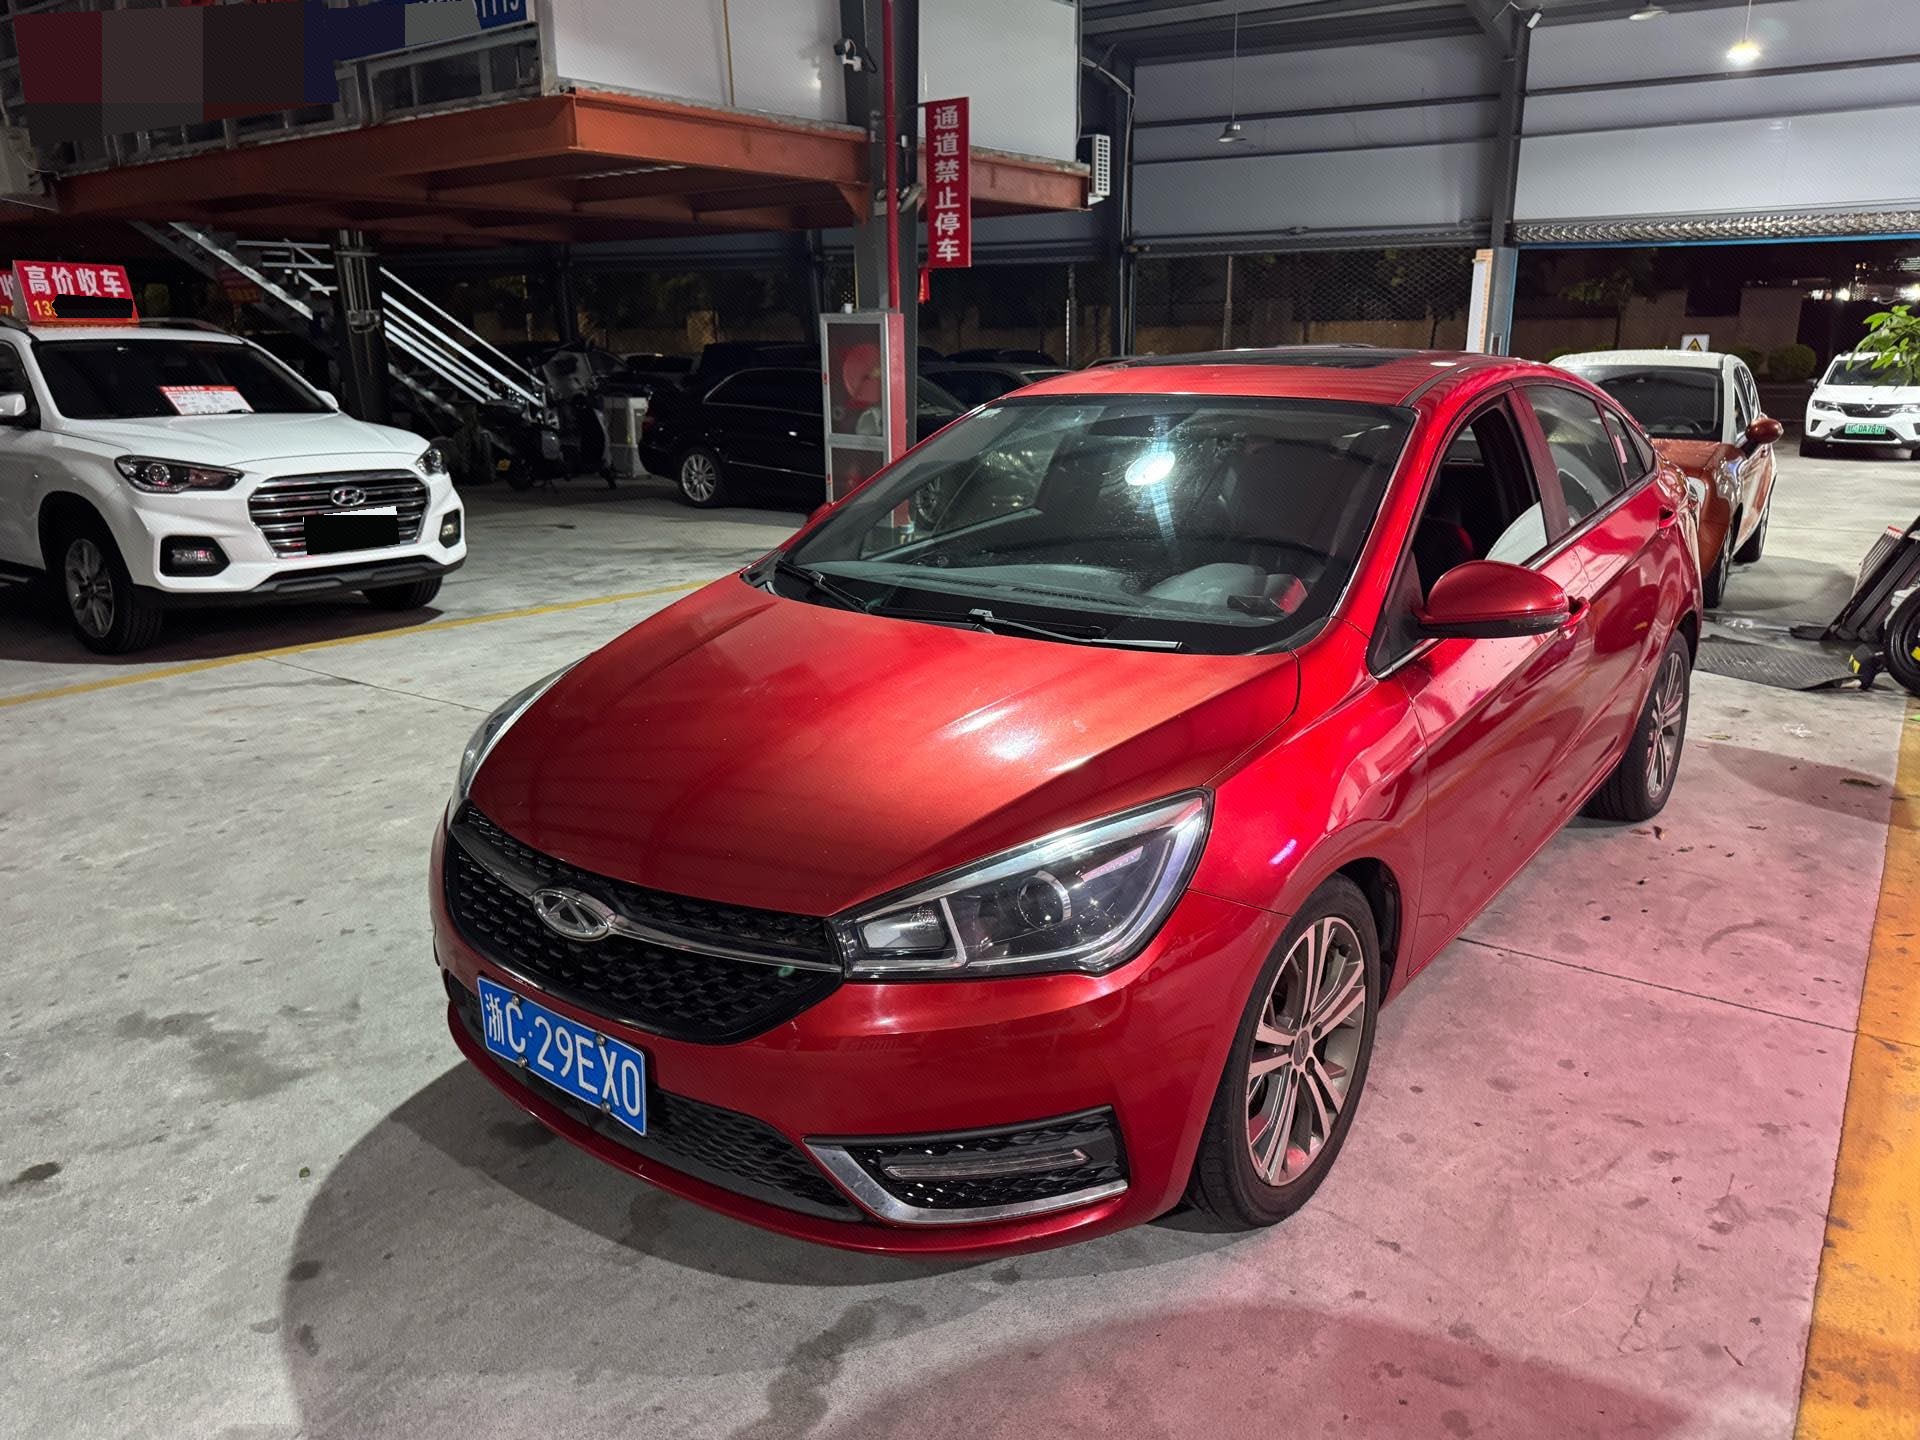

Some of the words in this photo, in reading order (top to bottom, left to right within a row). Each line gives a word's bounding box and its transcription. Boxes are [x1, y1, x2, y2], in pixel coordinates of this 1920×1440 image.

[933, 105, 960, 262] 通道禁止停车
[24, 266, 125, 297] 高价收车
